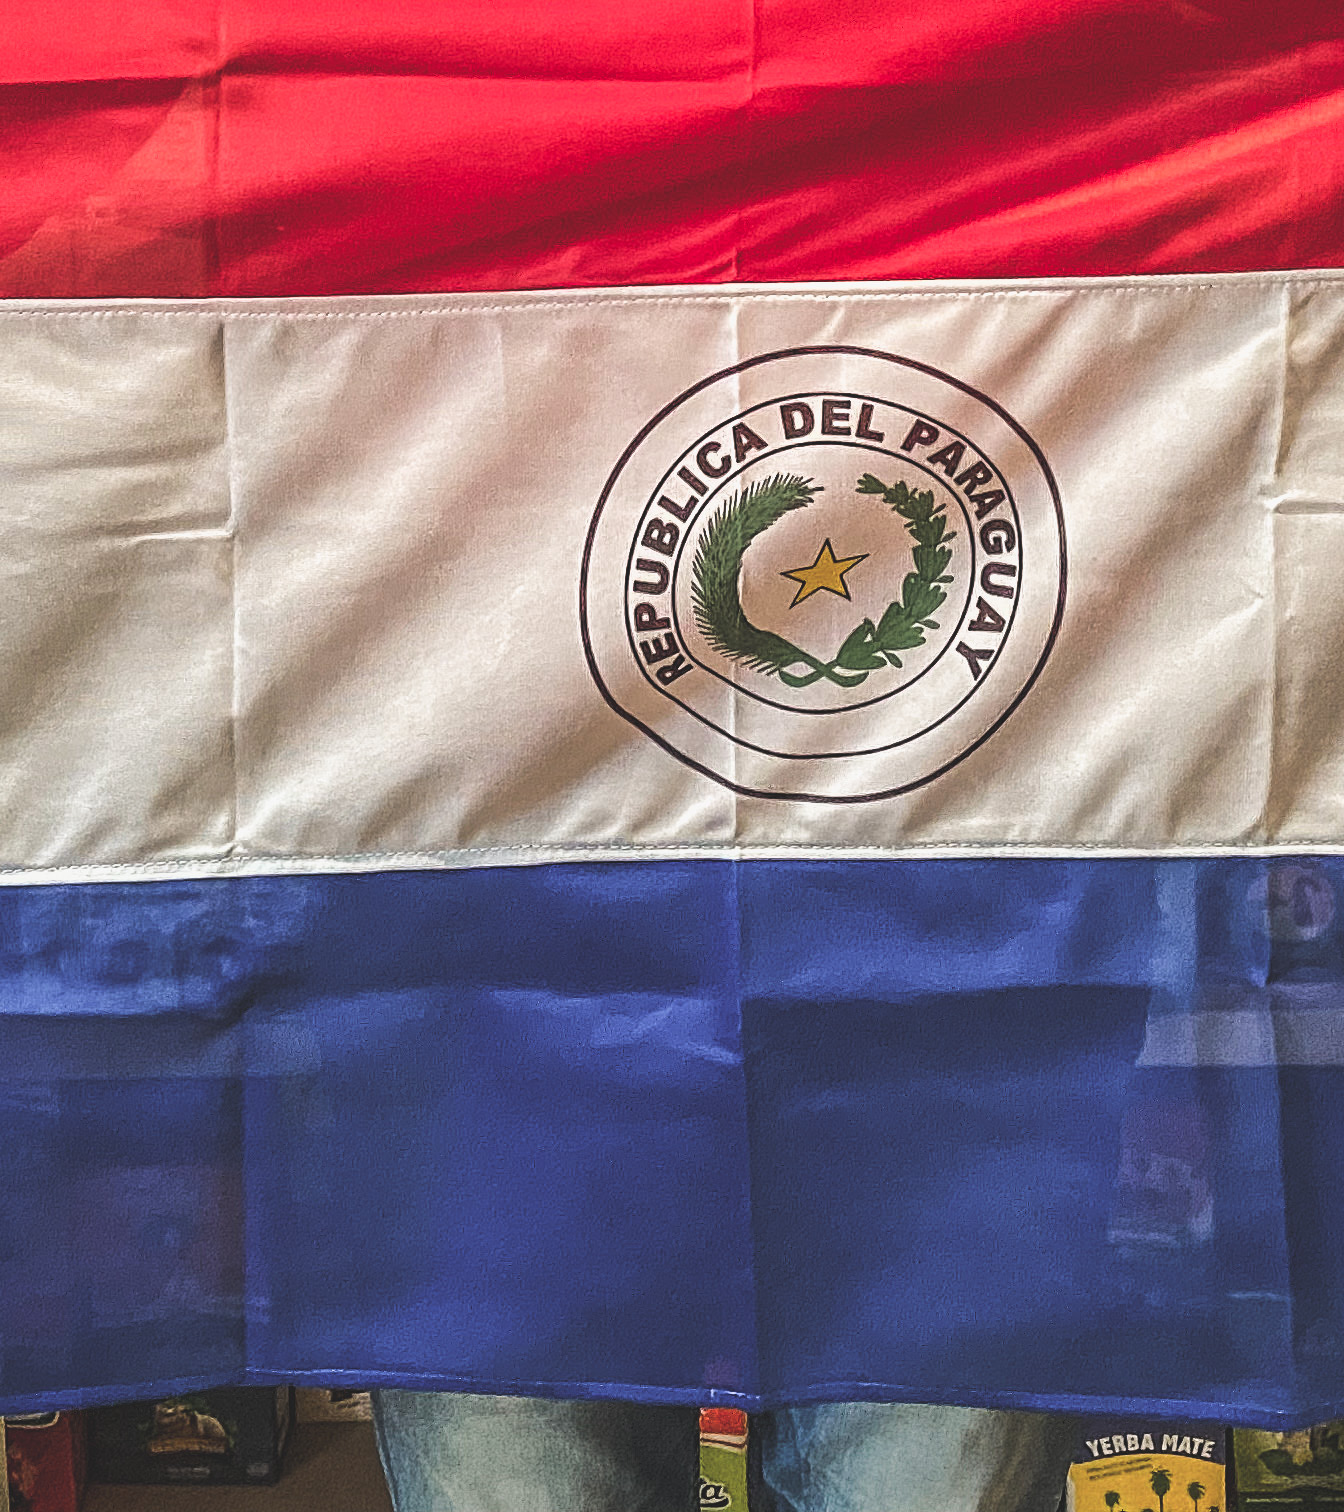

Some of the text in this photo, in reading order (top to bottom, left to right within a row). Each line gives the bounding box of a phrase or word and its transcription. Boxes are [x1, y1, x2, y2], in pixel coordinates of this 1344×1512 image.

[633, 400, 1017, 687] REPUBLICA DEL PARAGUAY
[1085, 1433, 1216, 1458] YERBA MATE
